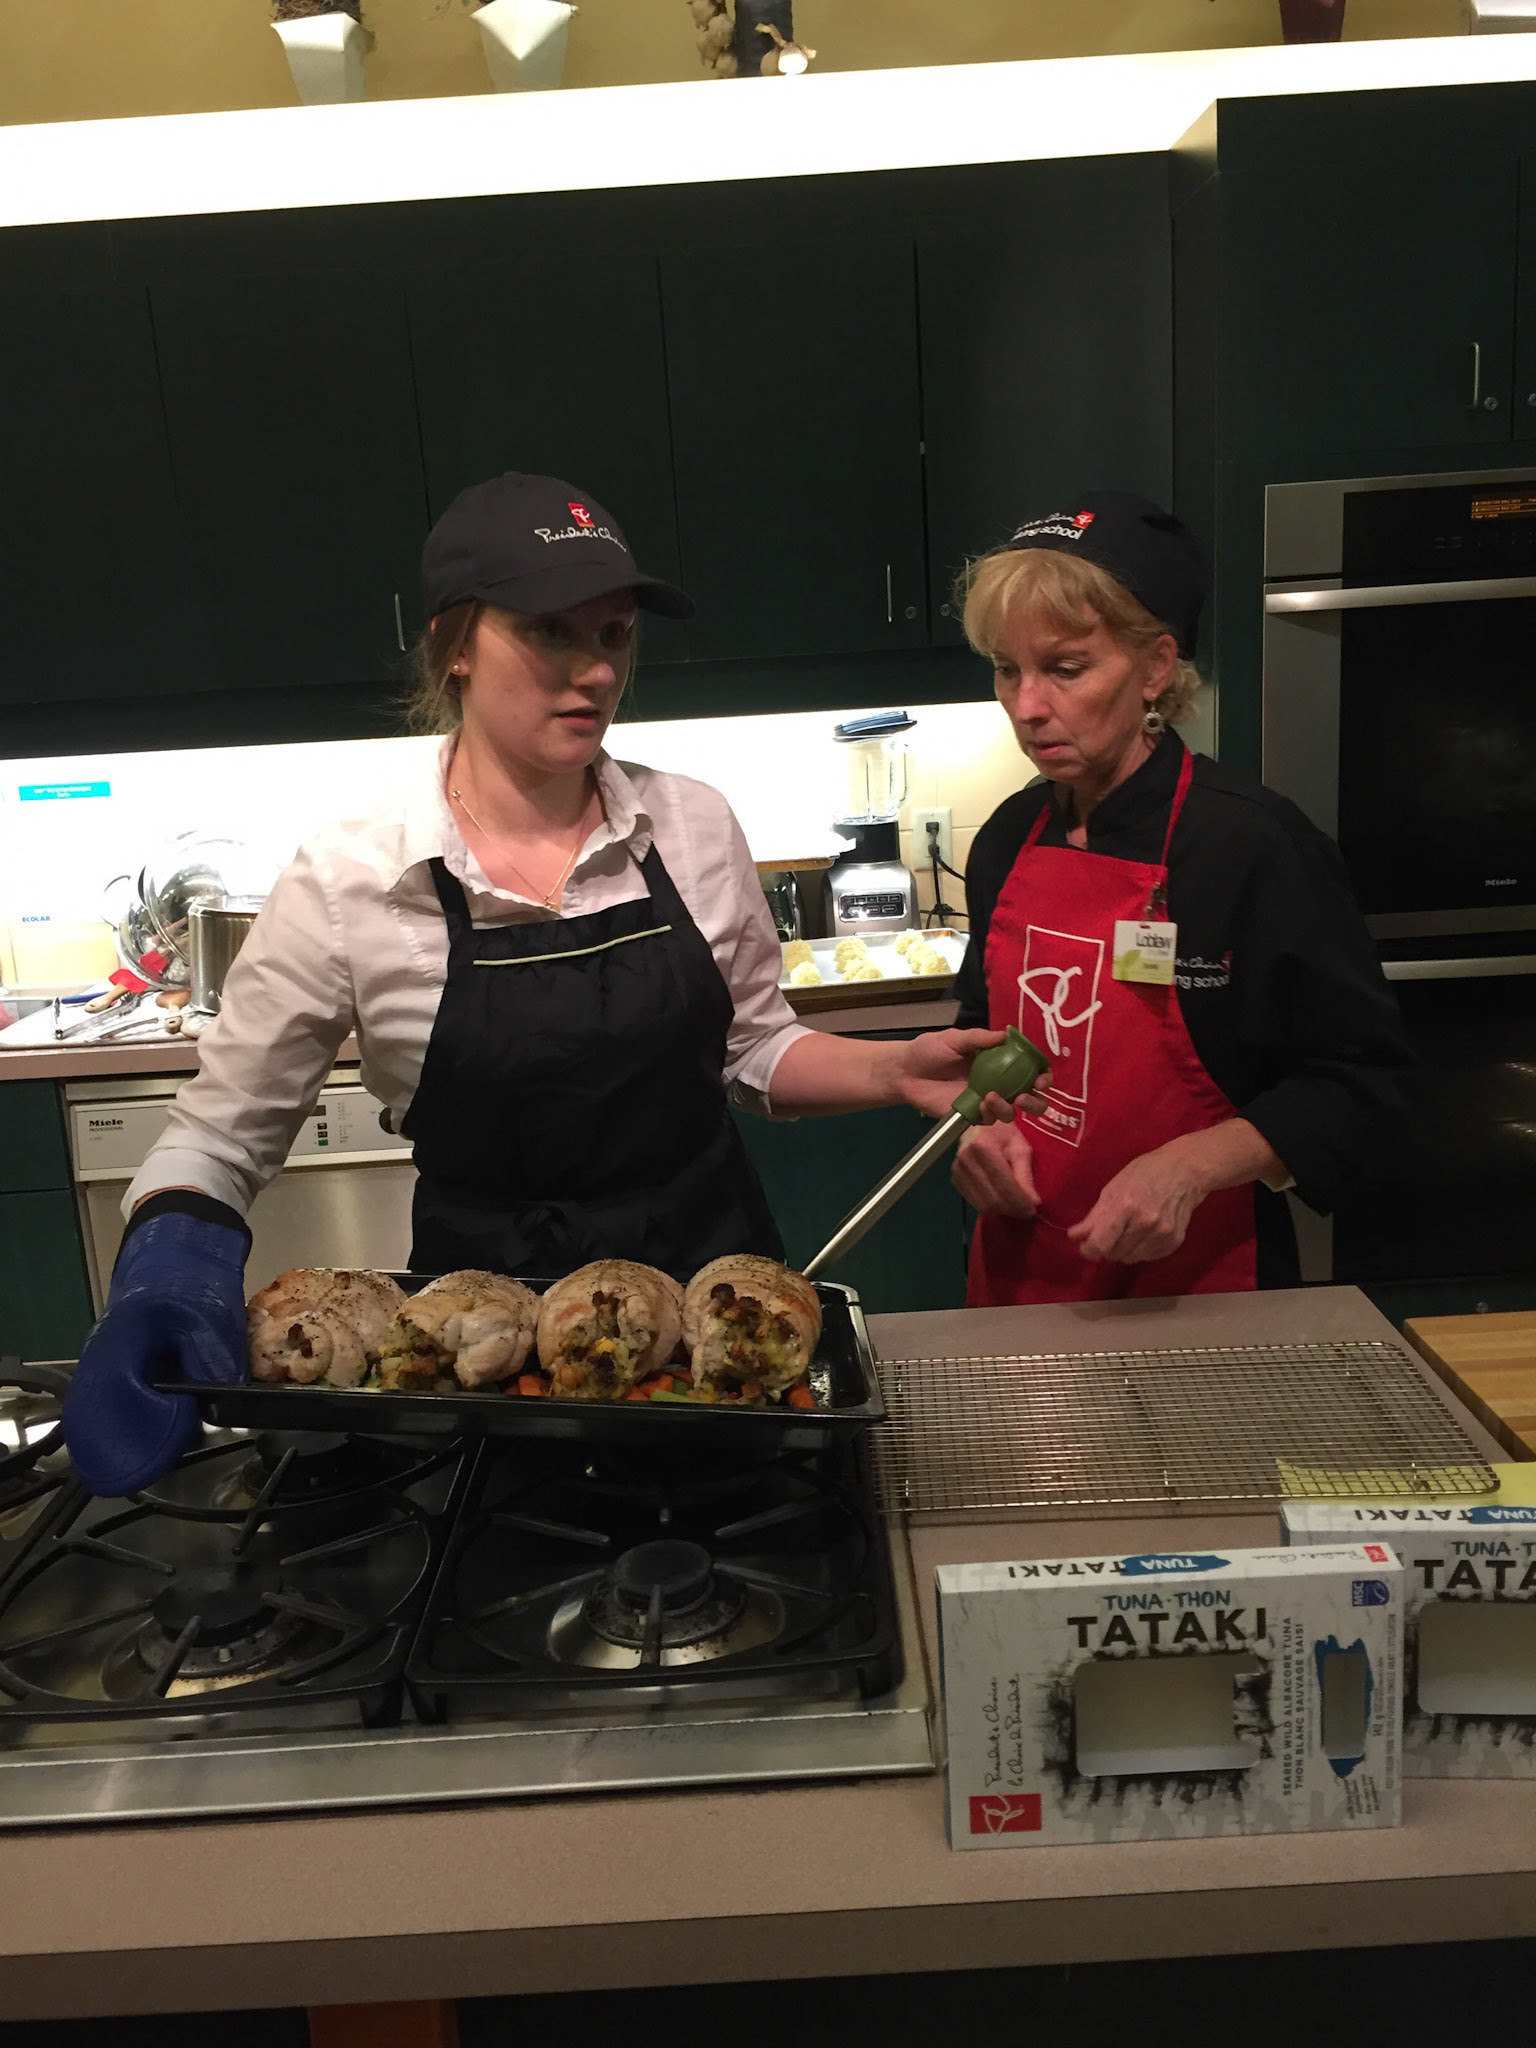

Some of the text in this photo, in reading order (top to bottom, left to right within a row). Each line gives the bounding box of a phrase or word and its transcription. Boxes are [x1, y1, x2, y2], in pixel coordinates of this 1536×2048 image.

[1040, 525, 1084, 540] school
[1484, 878, 1517, 887] Miele
[22, 915, 51, 923] ECOLAB
[89, 1119, 124, 1127] Miele
[1450, 1541, 1511, 1557] TUNA
[1008, 1560, 1126, 1579] TATAKI
[1140, 1557, 1199, 1571] TUNA
[1413, 1559, 1536, 1591] TATA
[1103, 1589, 1231, 1612] TUNA THON
[1354, 1582, 1364, 1605] MSC
[1067, 1607, 1267, 1648] TATAKI
[1283, 1617, 1293, 1796] SEARED WILD ALBACORE TUNA
[1295, 1623, 1305, 1789] THON BLANC SAUVAGE SAISI
